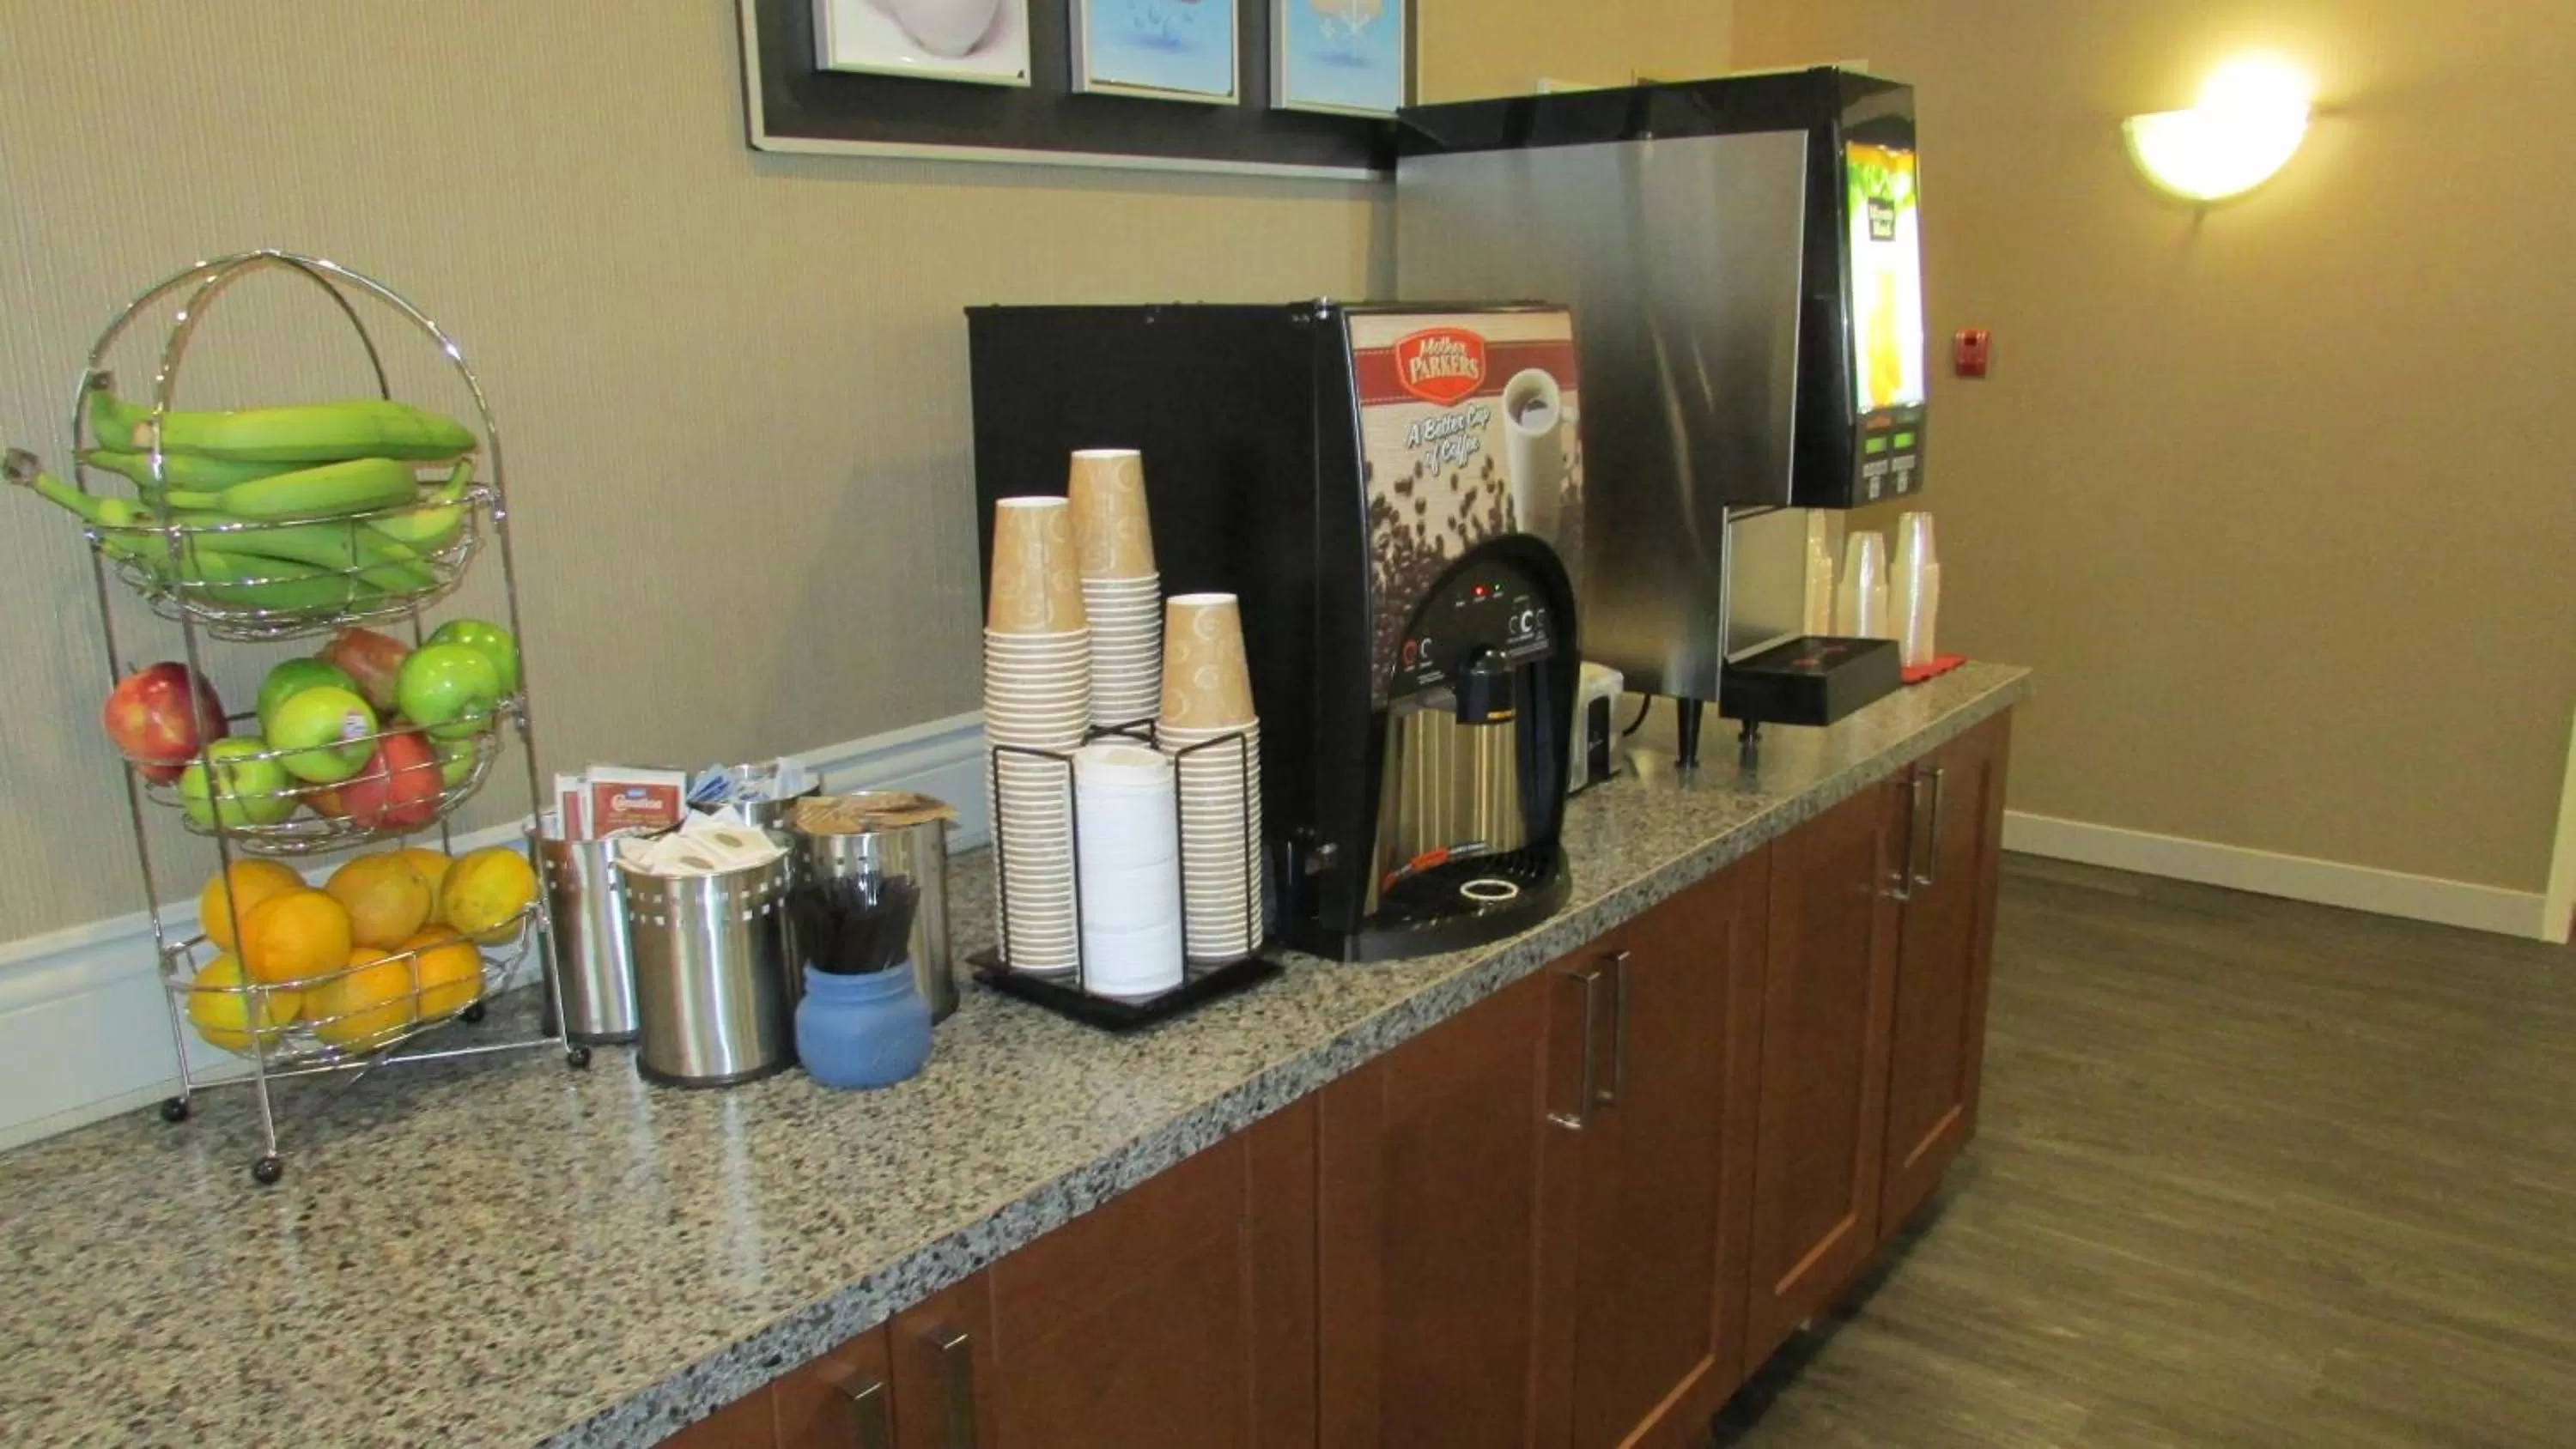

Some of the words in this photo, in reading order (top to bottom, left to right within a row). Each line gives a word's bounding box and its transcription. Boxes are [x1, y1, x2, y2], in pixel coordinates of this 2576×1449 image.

[1409, 353, 1479, 385] PARKERS
[1407, 423, 1421, 448] A
[1425, 414, 1466, 442] Better
[1467, 403, 1492, 430] Cup
[1425, 444, 1441, 477] of
[1442, 433, 1481, 469] Coffee
